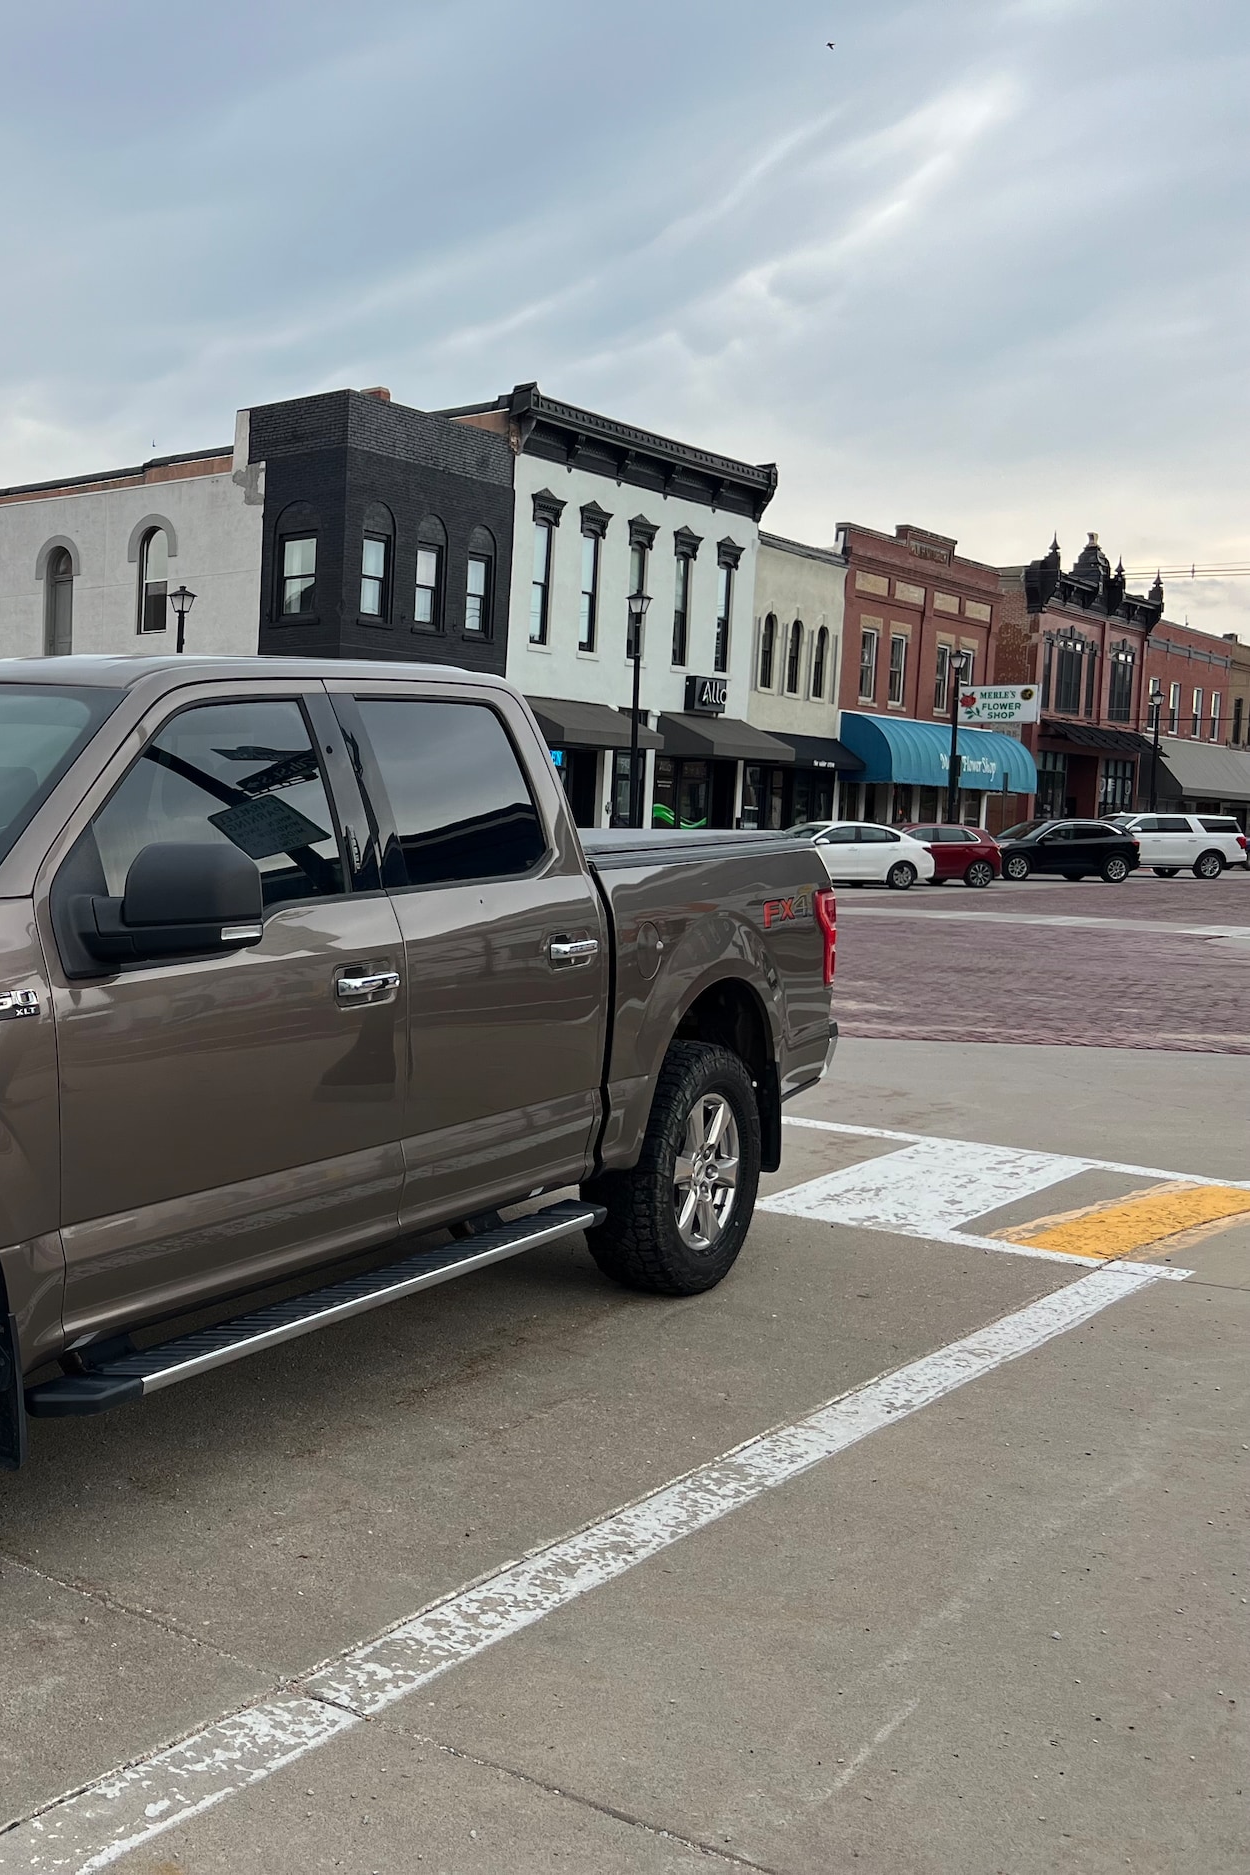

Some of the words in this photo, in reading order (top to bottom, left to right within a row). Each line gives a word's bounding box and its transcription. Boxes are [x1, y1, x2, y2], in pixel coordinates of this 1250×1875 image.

[980, 691, 1016, 700] MERLE'S
[981, 702, 1022, 711] FLOWER
[987, 711, 1015, 720] SHOP
[763, 894, 812, 929] FX4
[15, 1006, 36, 1016] XLT
